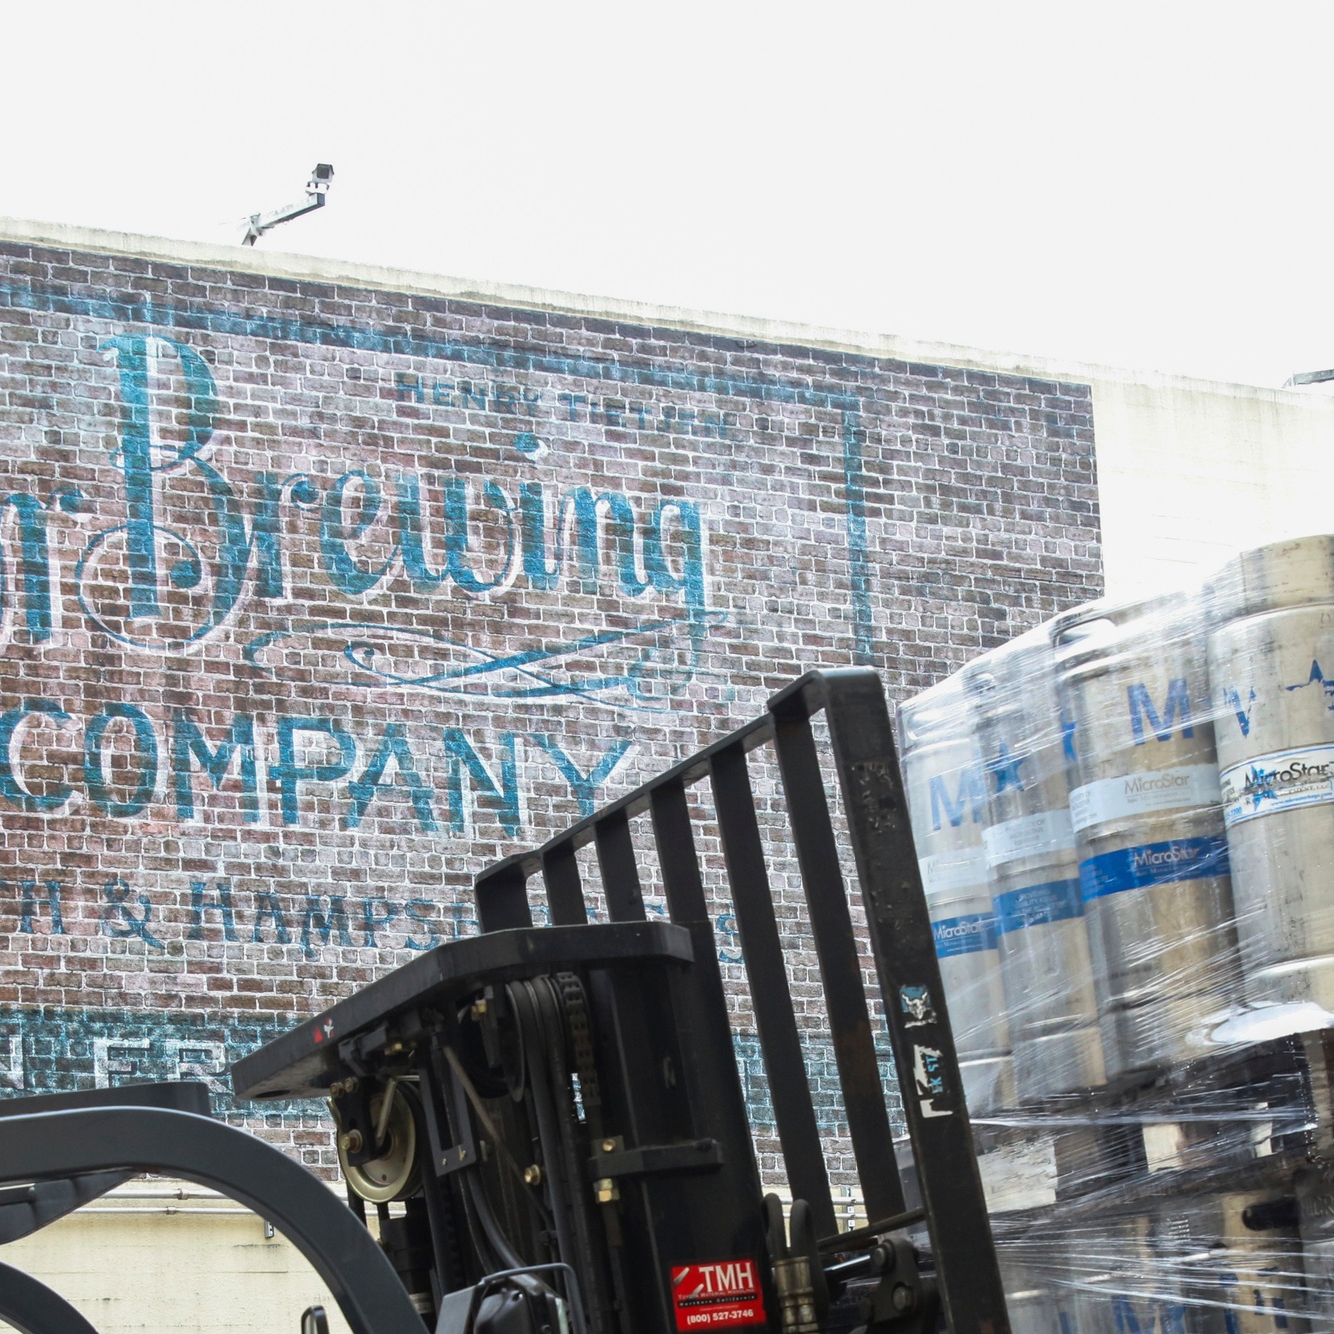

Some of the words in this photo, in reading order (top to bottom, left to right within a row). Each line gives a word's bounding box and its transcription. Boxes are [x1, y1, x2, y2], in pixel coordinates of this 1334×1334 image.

[75, 332, 729, 712] Brewing
[1126, 678, 1194, 747] M
[1124, 773, 1190, 796] MicroStar
[101, 877, 167, 951] &
[698, 1262, 754, 1292] TMH
[686, 1313, 711, 1325] (800)
[712, 1309, 754, 1321] 527-3746
